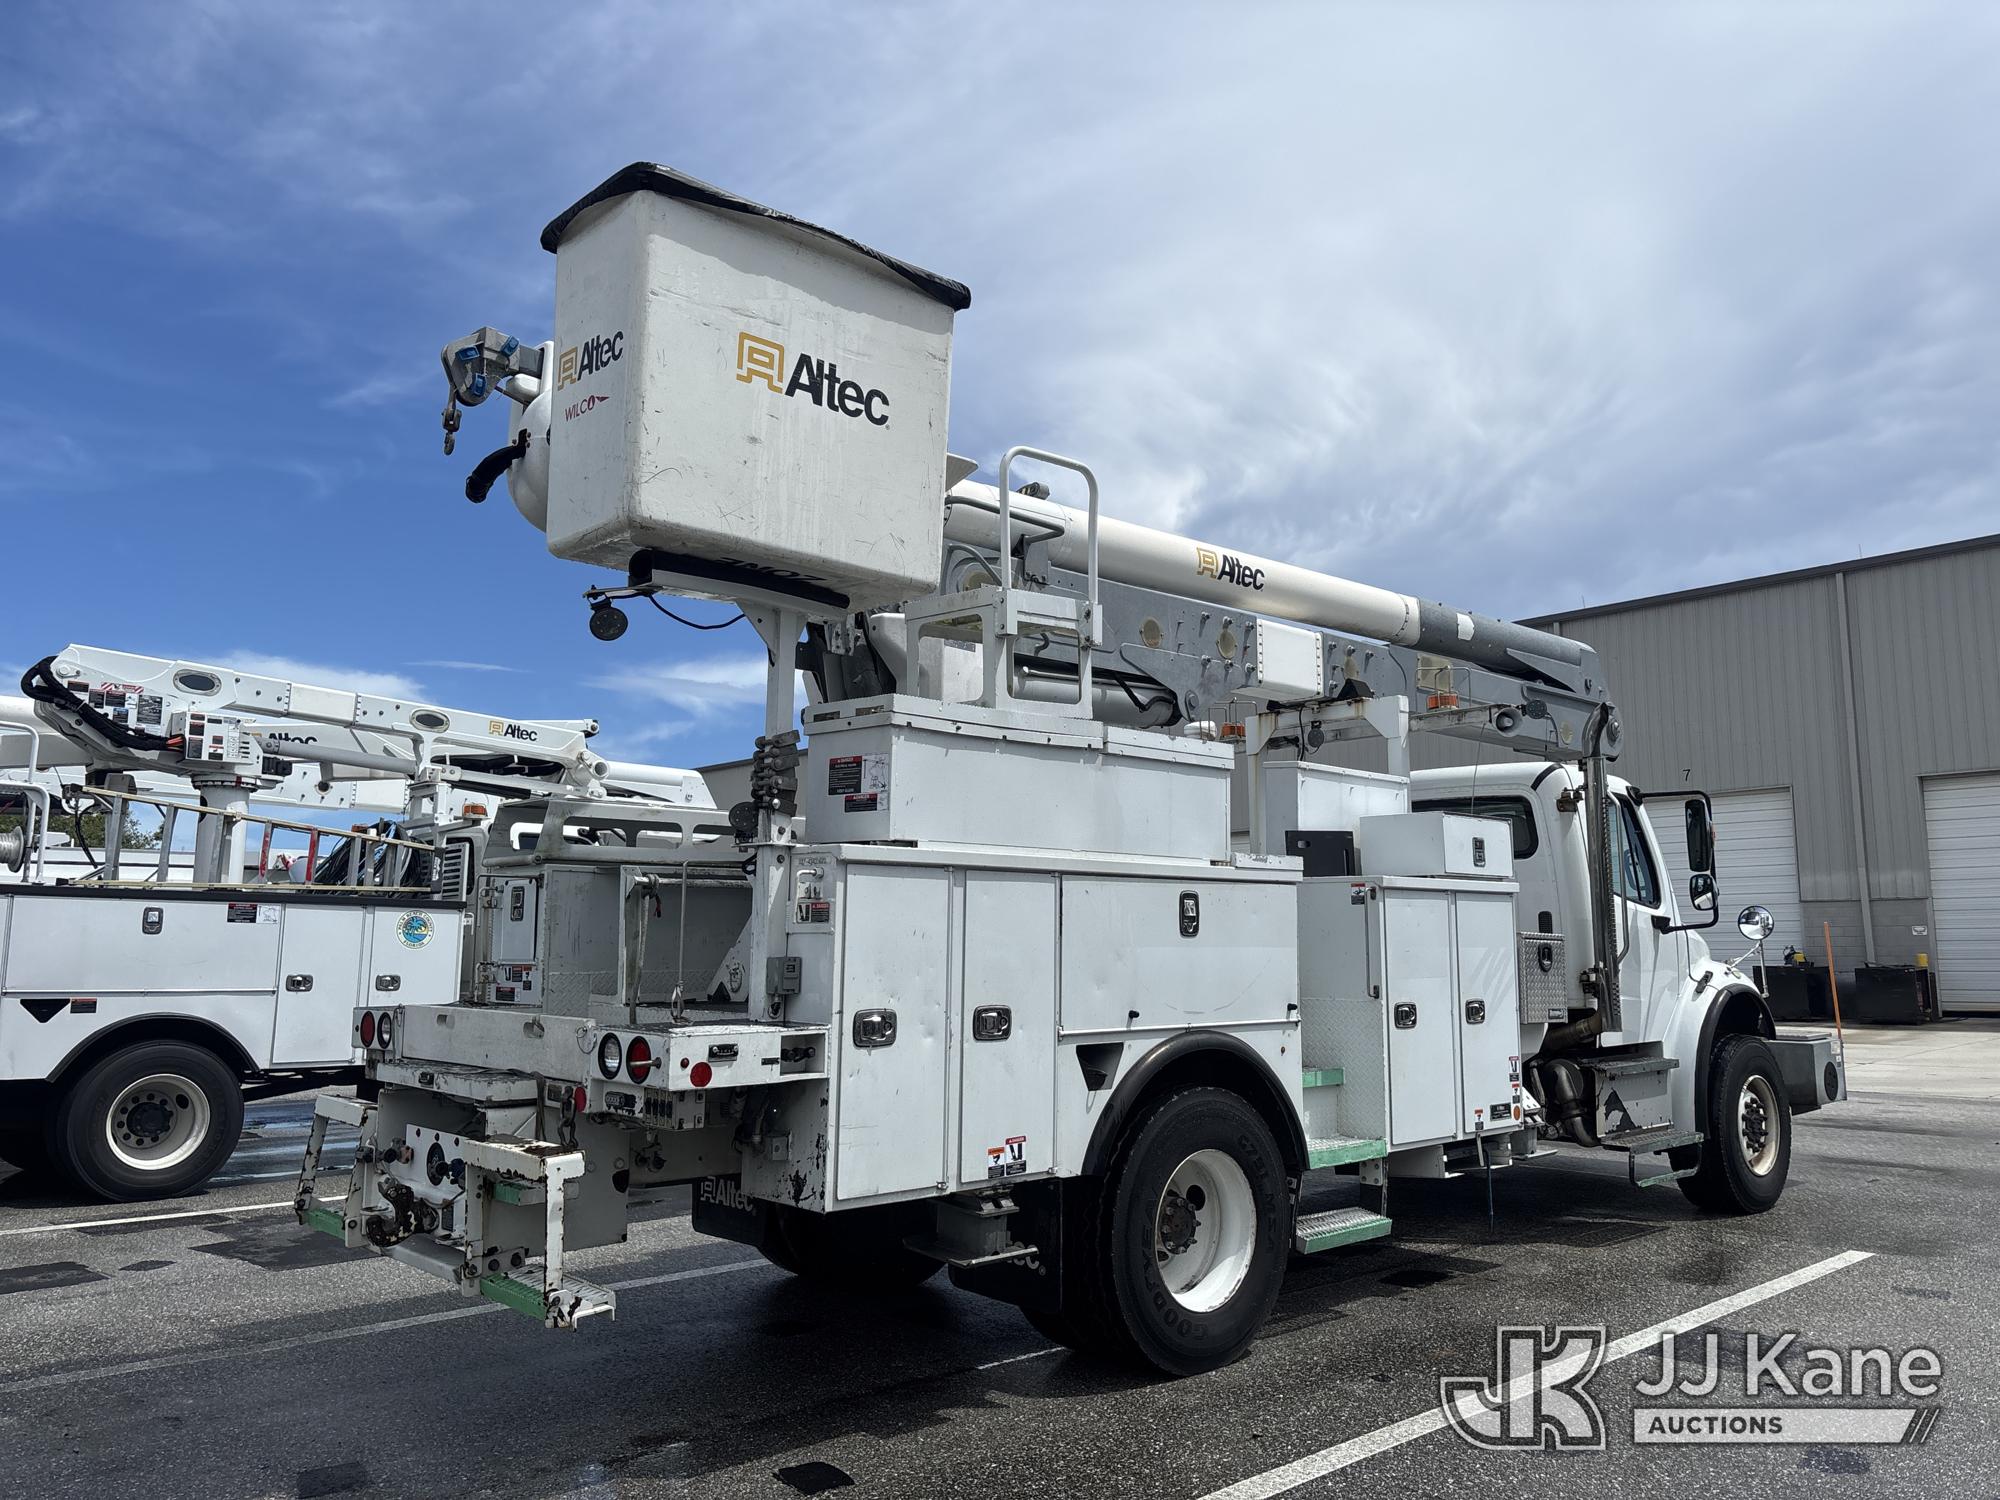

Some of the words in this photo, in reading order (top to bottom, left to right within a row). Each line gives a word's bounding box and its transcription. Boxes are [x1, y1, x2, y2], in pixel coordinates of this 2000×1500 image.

[577, 331, 624, 381] Altec
[785, 353, 890, 426] Altec
[564, 394, 596, 422] WILCO
[1217, 554, 1265, 591] Altec
[504, 723, 538, 742] Altec
[1683, 769, 1690, 781] 7
